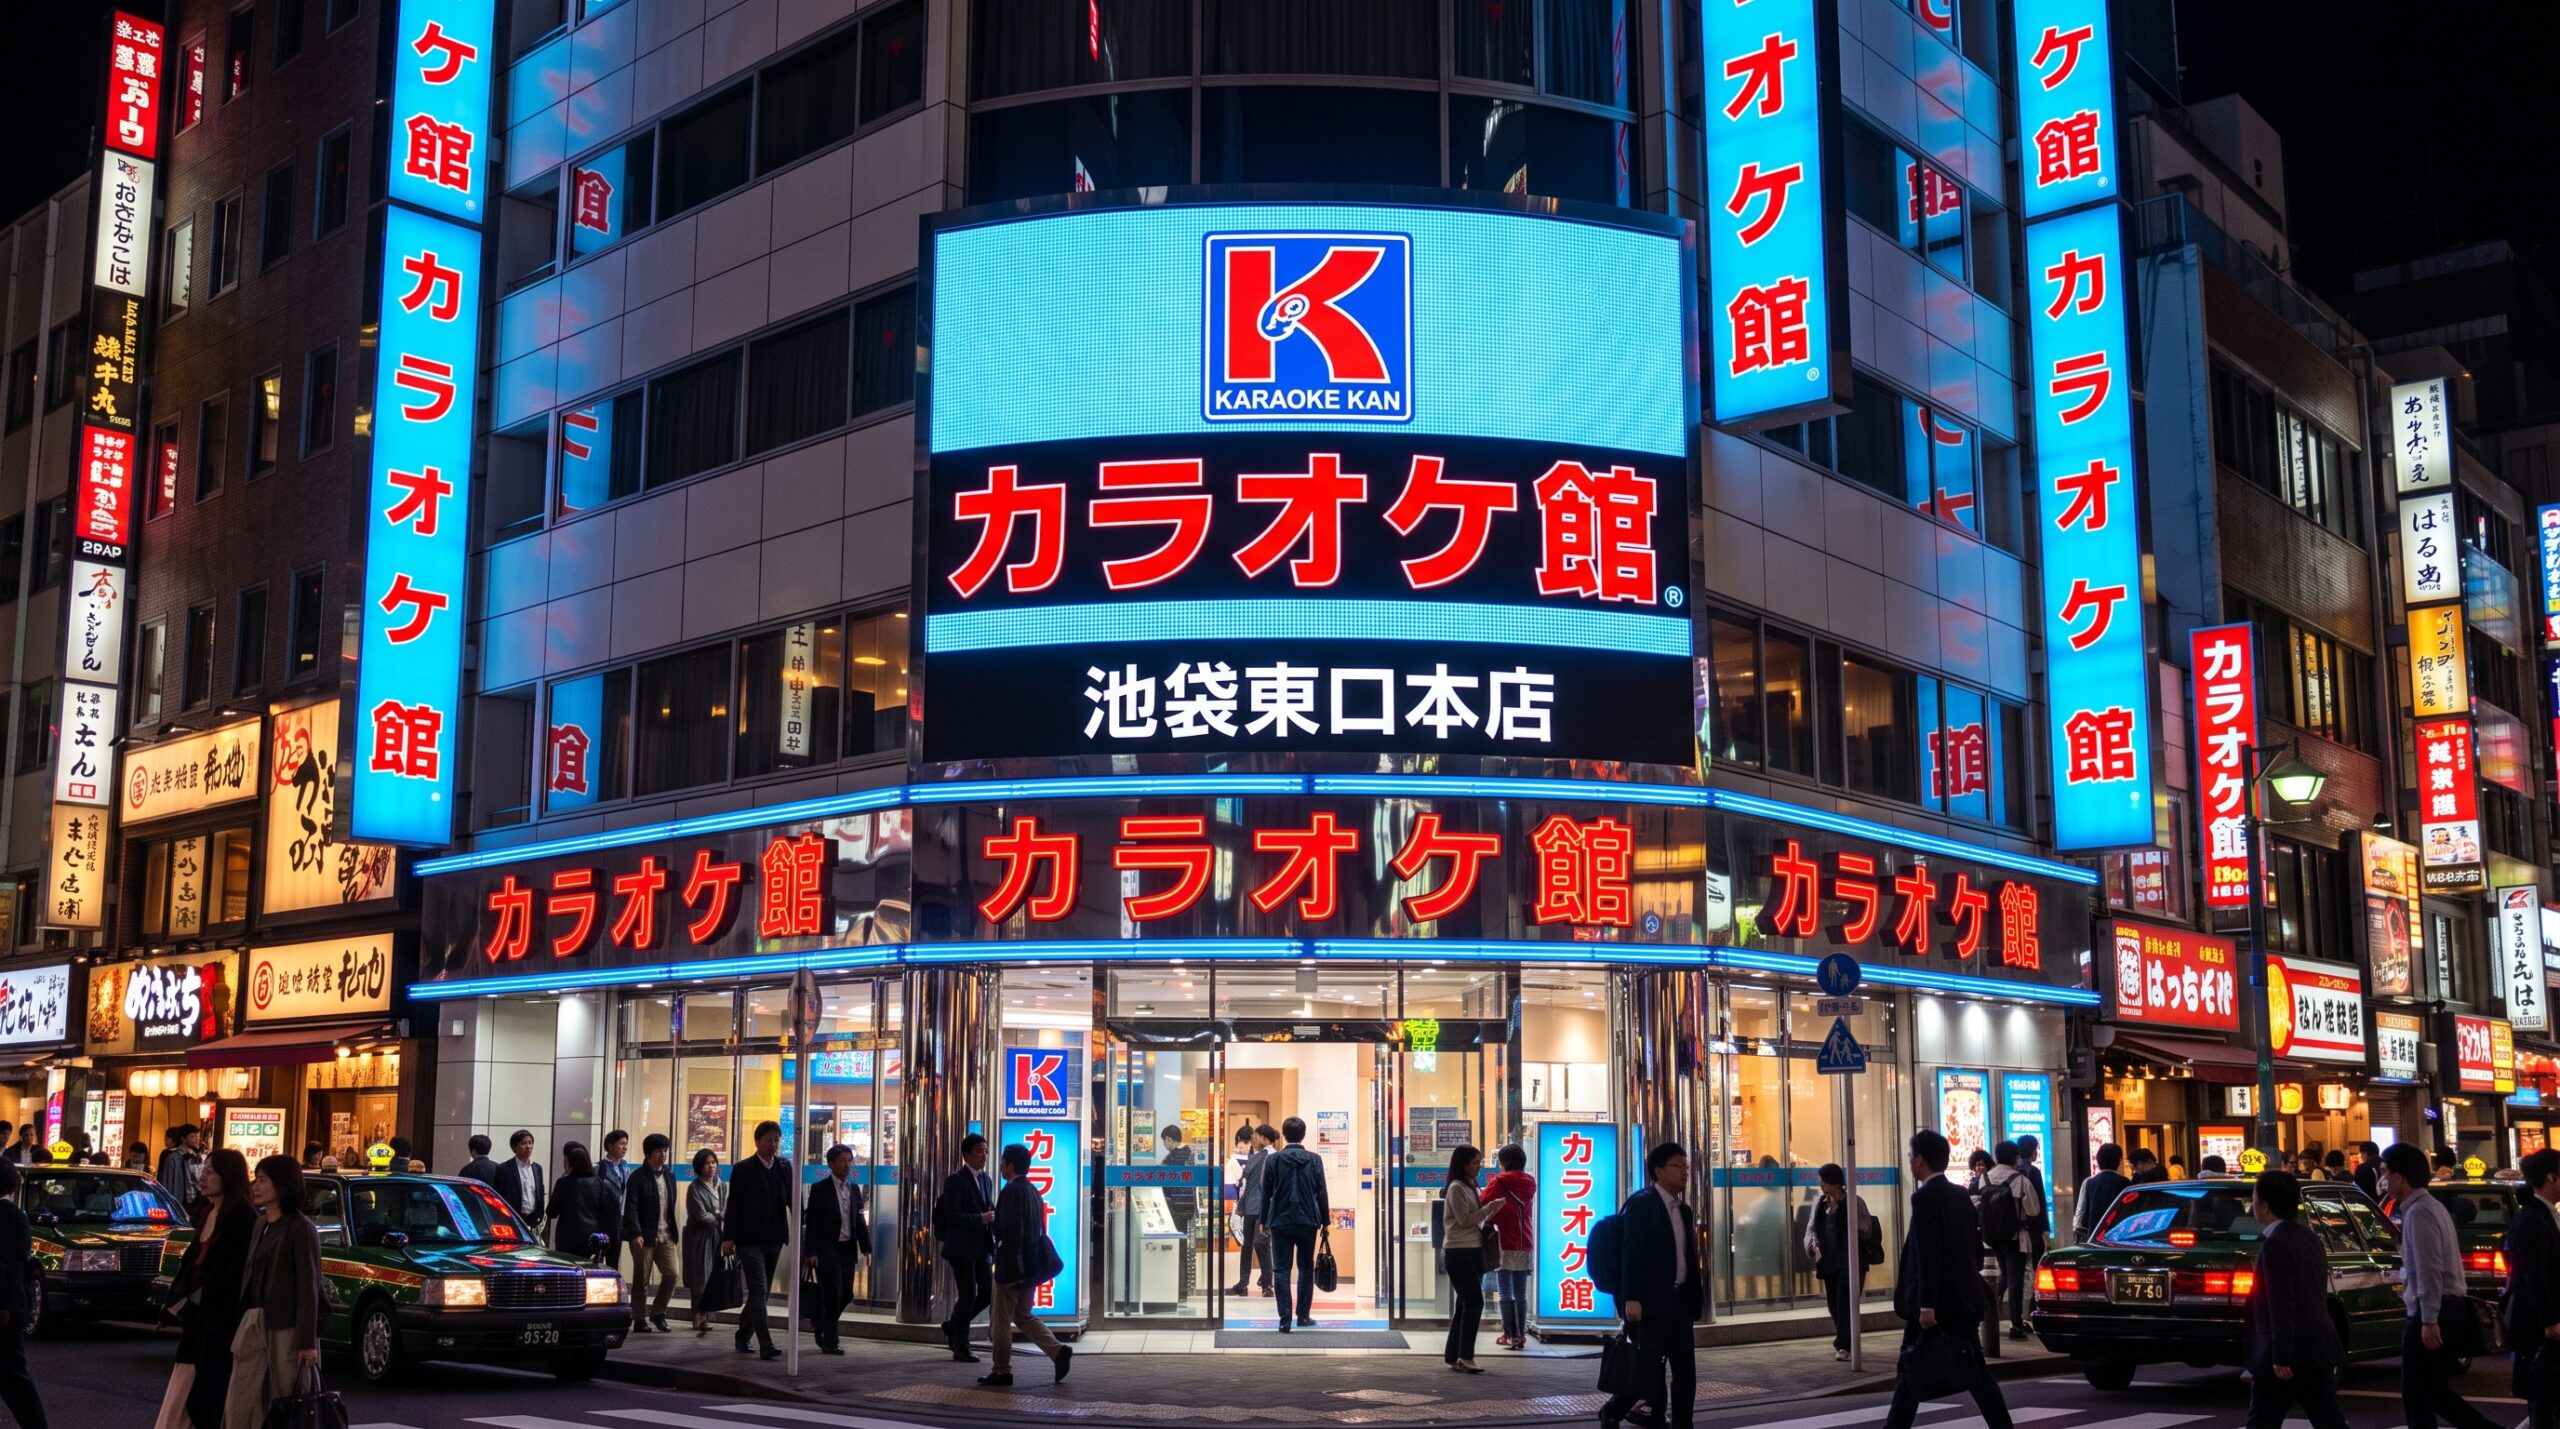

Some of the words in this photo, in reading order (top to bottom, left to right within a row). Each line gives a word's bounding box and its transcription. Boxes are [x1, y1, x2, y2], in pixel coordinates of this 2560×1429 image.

[2030, 24, 2101, 189] ケ館
[1723, 0, 1811, 377] オケ館
[1215, 389, 1341, 410] KARAOKE
[1347, 389, 1401, 411] KAN
[369, 249, 464, 781] カラオケ館
[948, 453, 1659, 605] カラオケ館
[2045, 249, 2136, 785] カラオケ館
[1083, 660, 1556, 743] 池袋東口本店
[485, 831, 827, 963] カラオケ館
[978, 812, 1635, 927] カラオケ館
[1772, 838, 2040, 971] カラオケ館
[1560, 1131, 1594, 1312] カラオケ館
